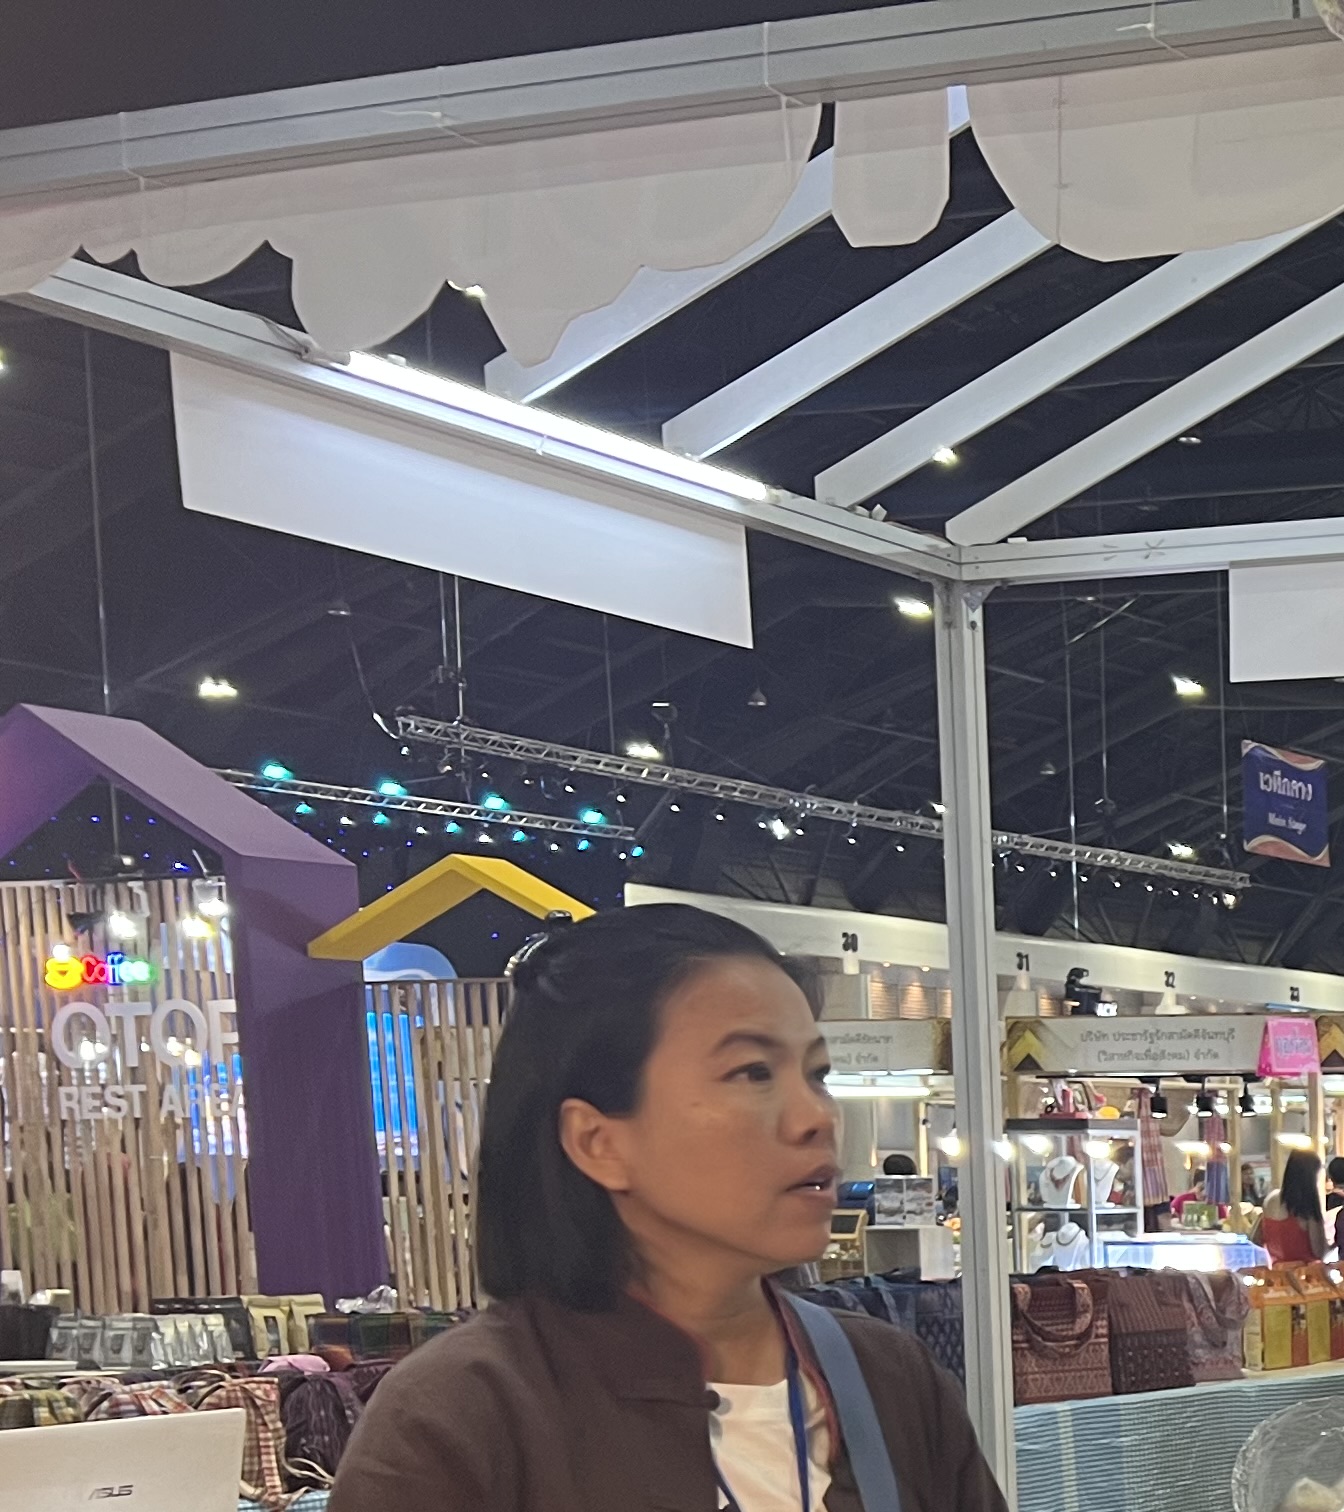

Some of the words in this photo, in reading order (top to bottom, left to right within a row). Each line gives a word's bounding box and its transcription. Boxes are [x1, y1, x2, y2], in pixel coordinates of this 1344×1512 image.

[1259, 770, 1313, 801] เวทีกลาง
[81, 952, 154, 986] Coffee
[60, 1084, 146, 1120] REST
[88, 1485, 134, 1501] ASUS
